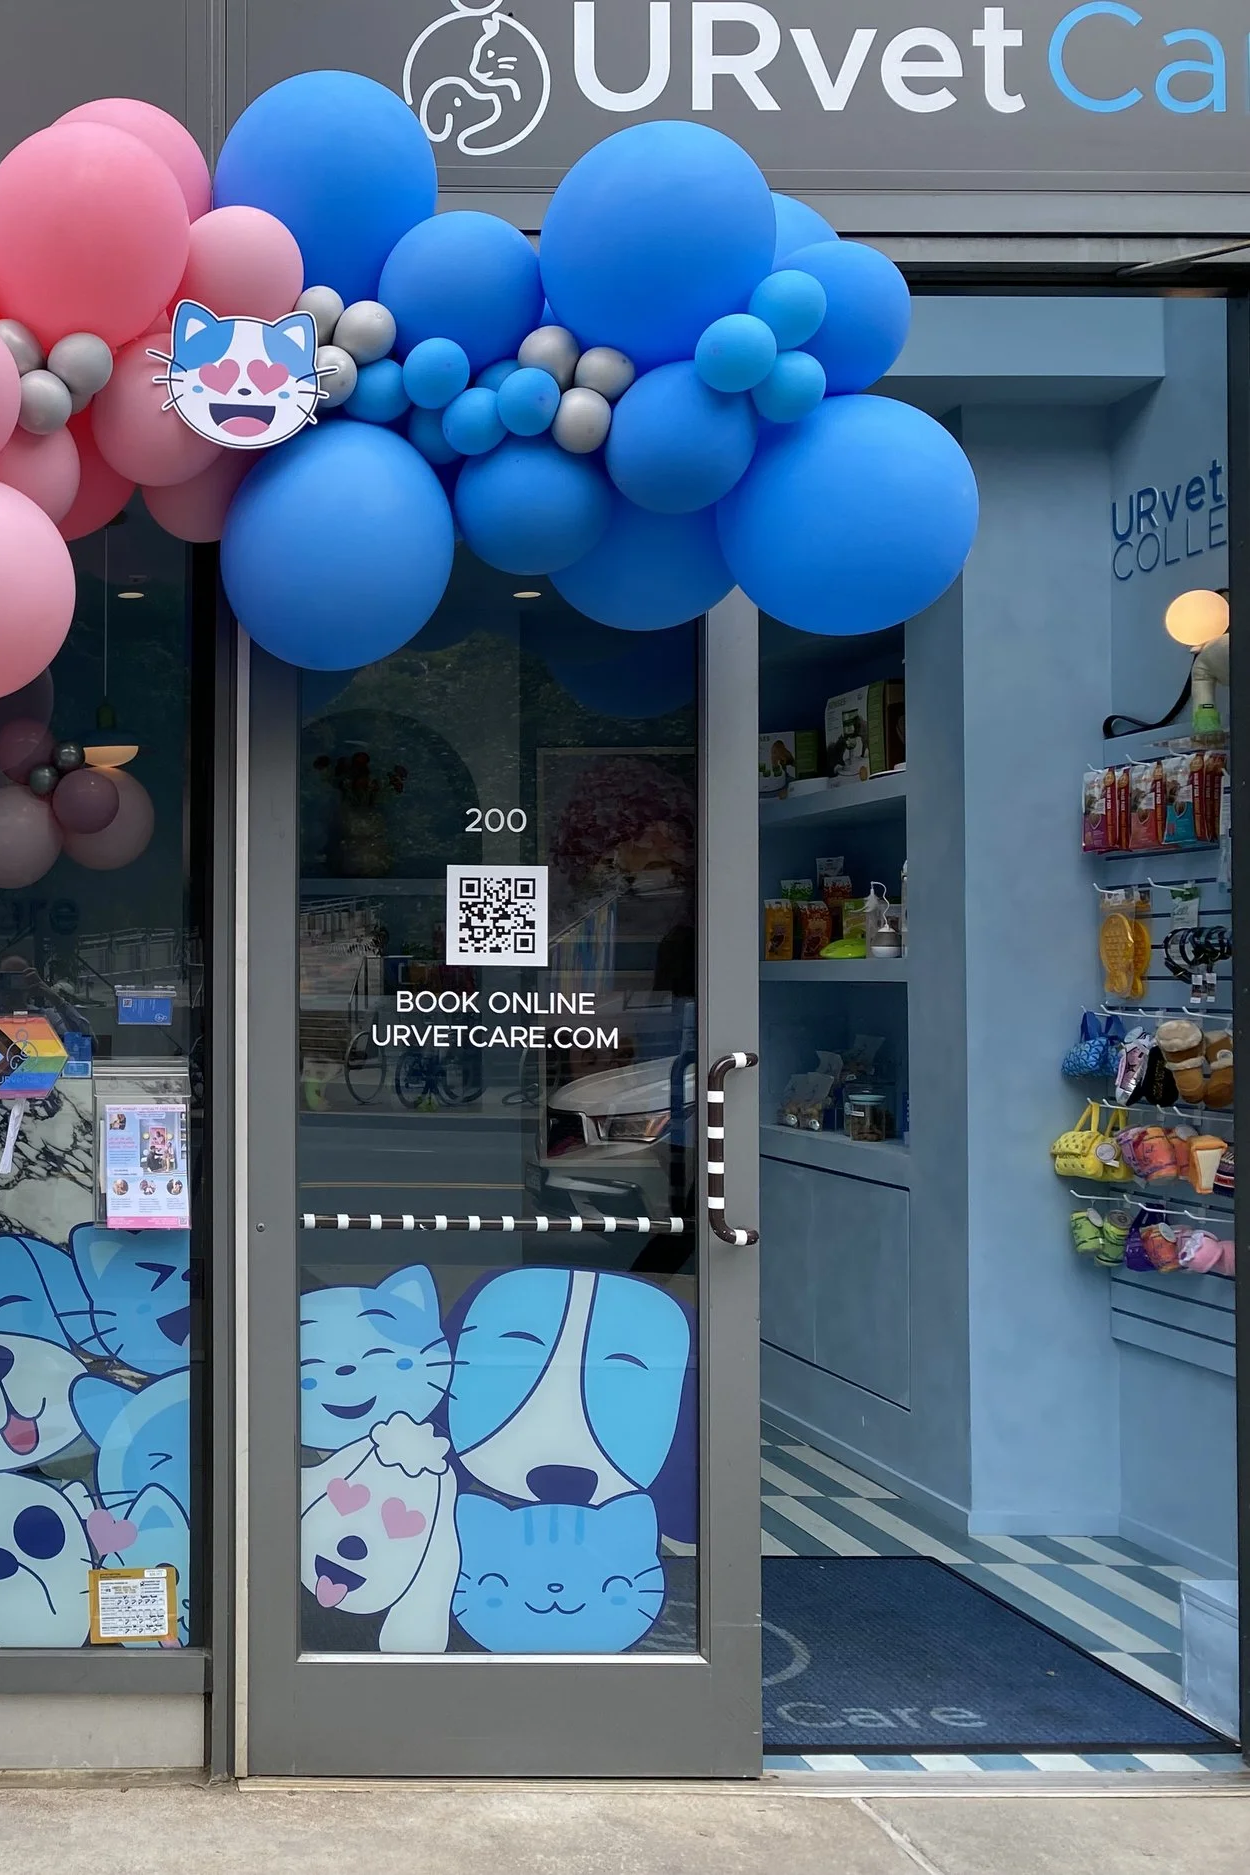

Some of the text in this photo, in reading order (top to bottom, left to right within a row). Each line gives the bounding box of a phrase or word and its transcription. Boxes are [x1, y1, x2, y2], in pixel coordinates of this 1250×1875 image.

[572, 0, 1250, 114] URvet Ca
[1111, 458, 1225, 542] URvet
[465, 807, 527, 833] 200
[396, 990, 596, 1015] BOOK ONLINE
[372, 1024, 619, 1050] URVETCARE.COM
[776, 1701, 989, 1729] Care
